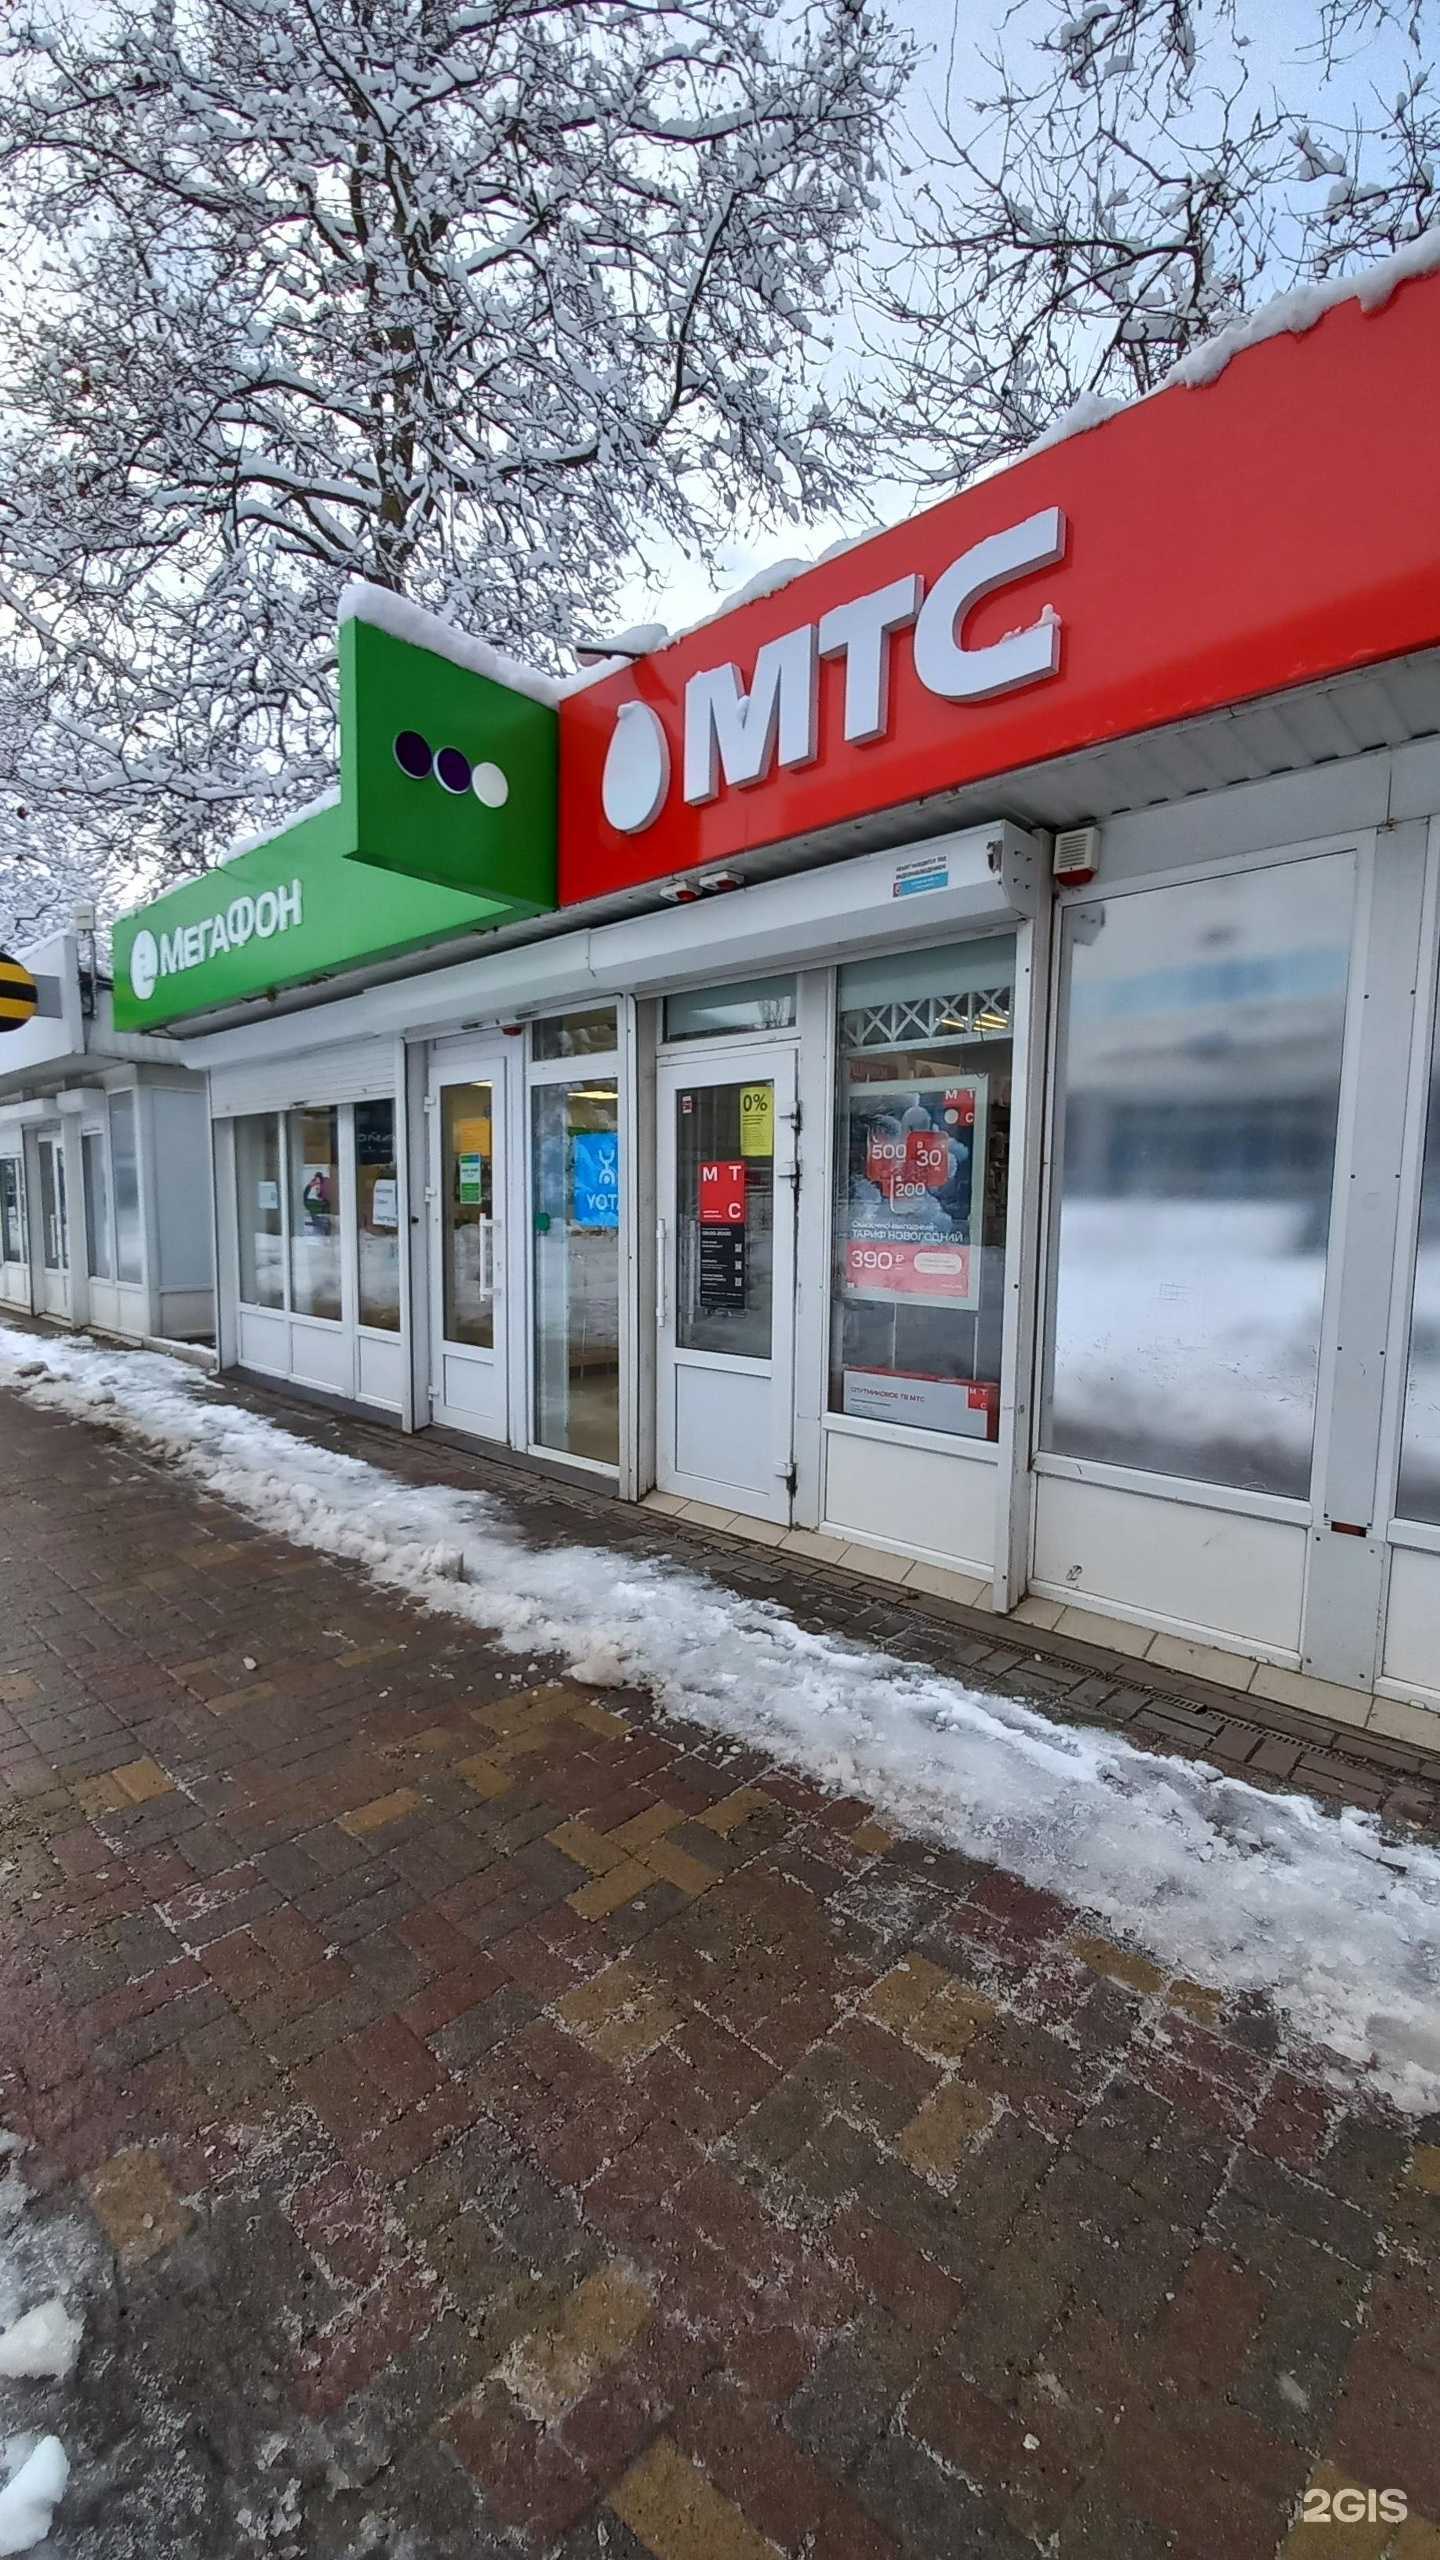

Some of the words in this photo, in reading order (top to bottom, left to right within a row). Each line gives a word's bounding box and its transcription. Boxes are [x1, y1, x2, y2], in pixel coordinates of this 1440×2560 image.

[683, 505, 1067, 806] МТС
[159, 878, 303, 978] МЕГАФОН
[743, 1094, 768, 1112] 0%
[871, 1144, 907, 1160] 500
[916, 1149, 942, 1167] 30
[895, 1182, 926, 1197] 200
[586, 1193, 619, 1210] YOT
[851, 1228, 886, 1240] ТАРИФ
[887, 1230, 963, 1242] НОВОГОДНИЙ
[851, 1250, 893, 1270] 390
